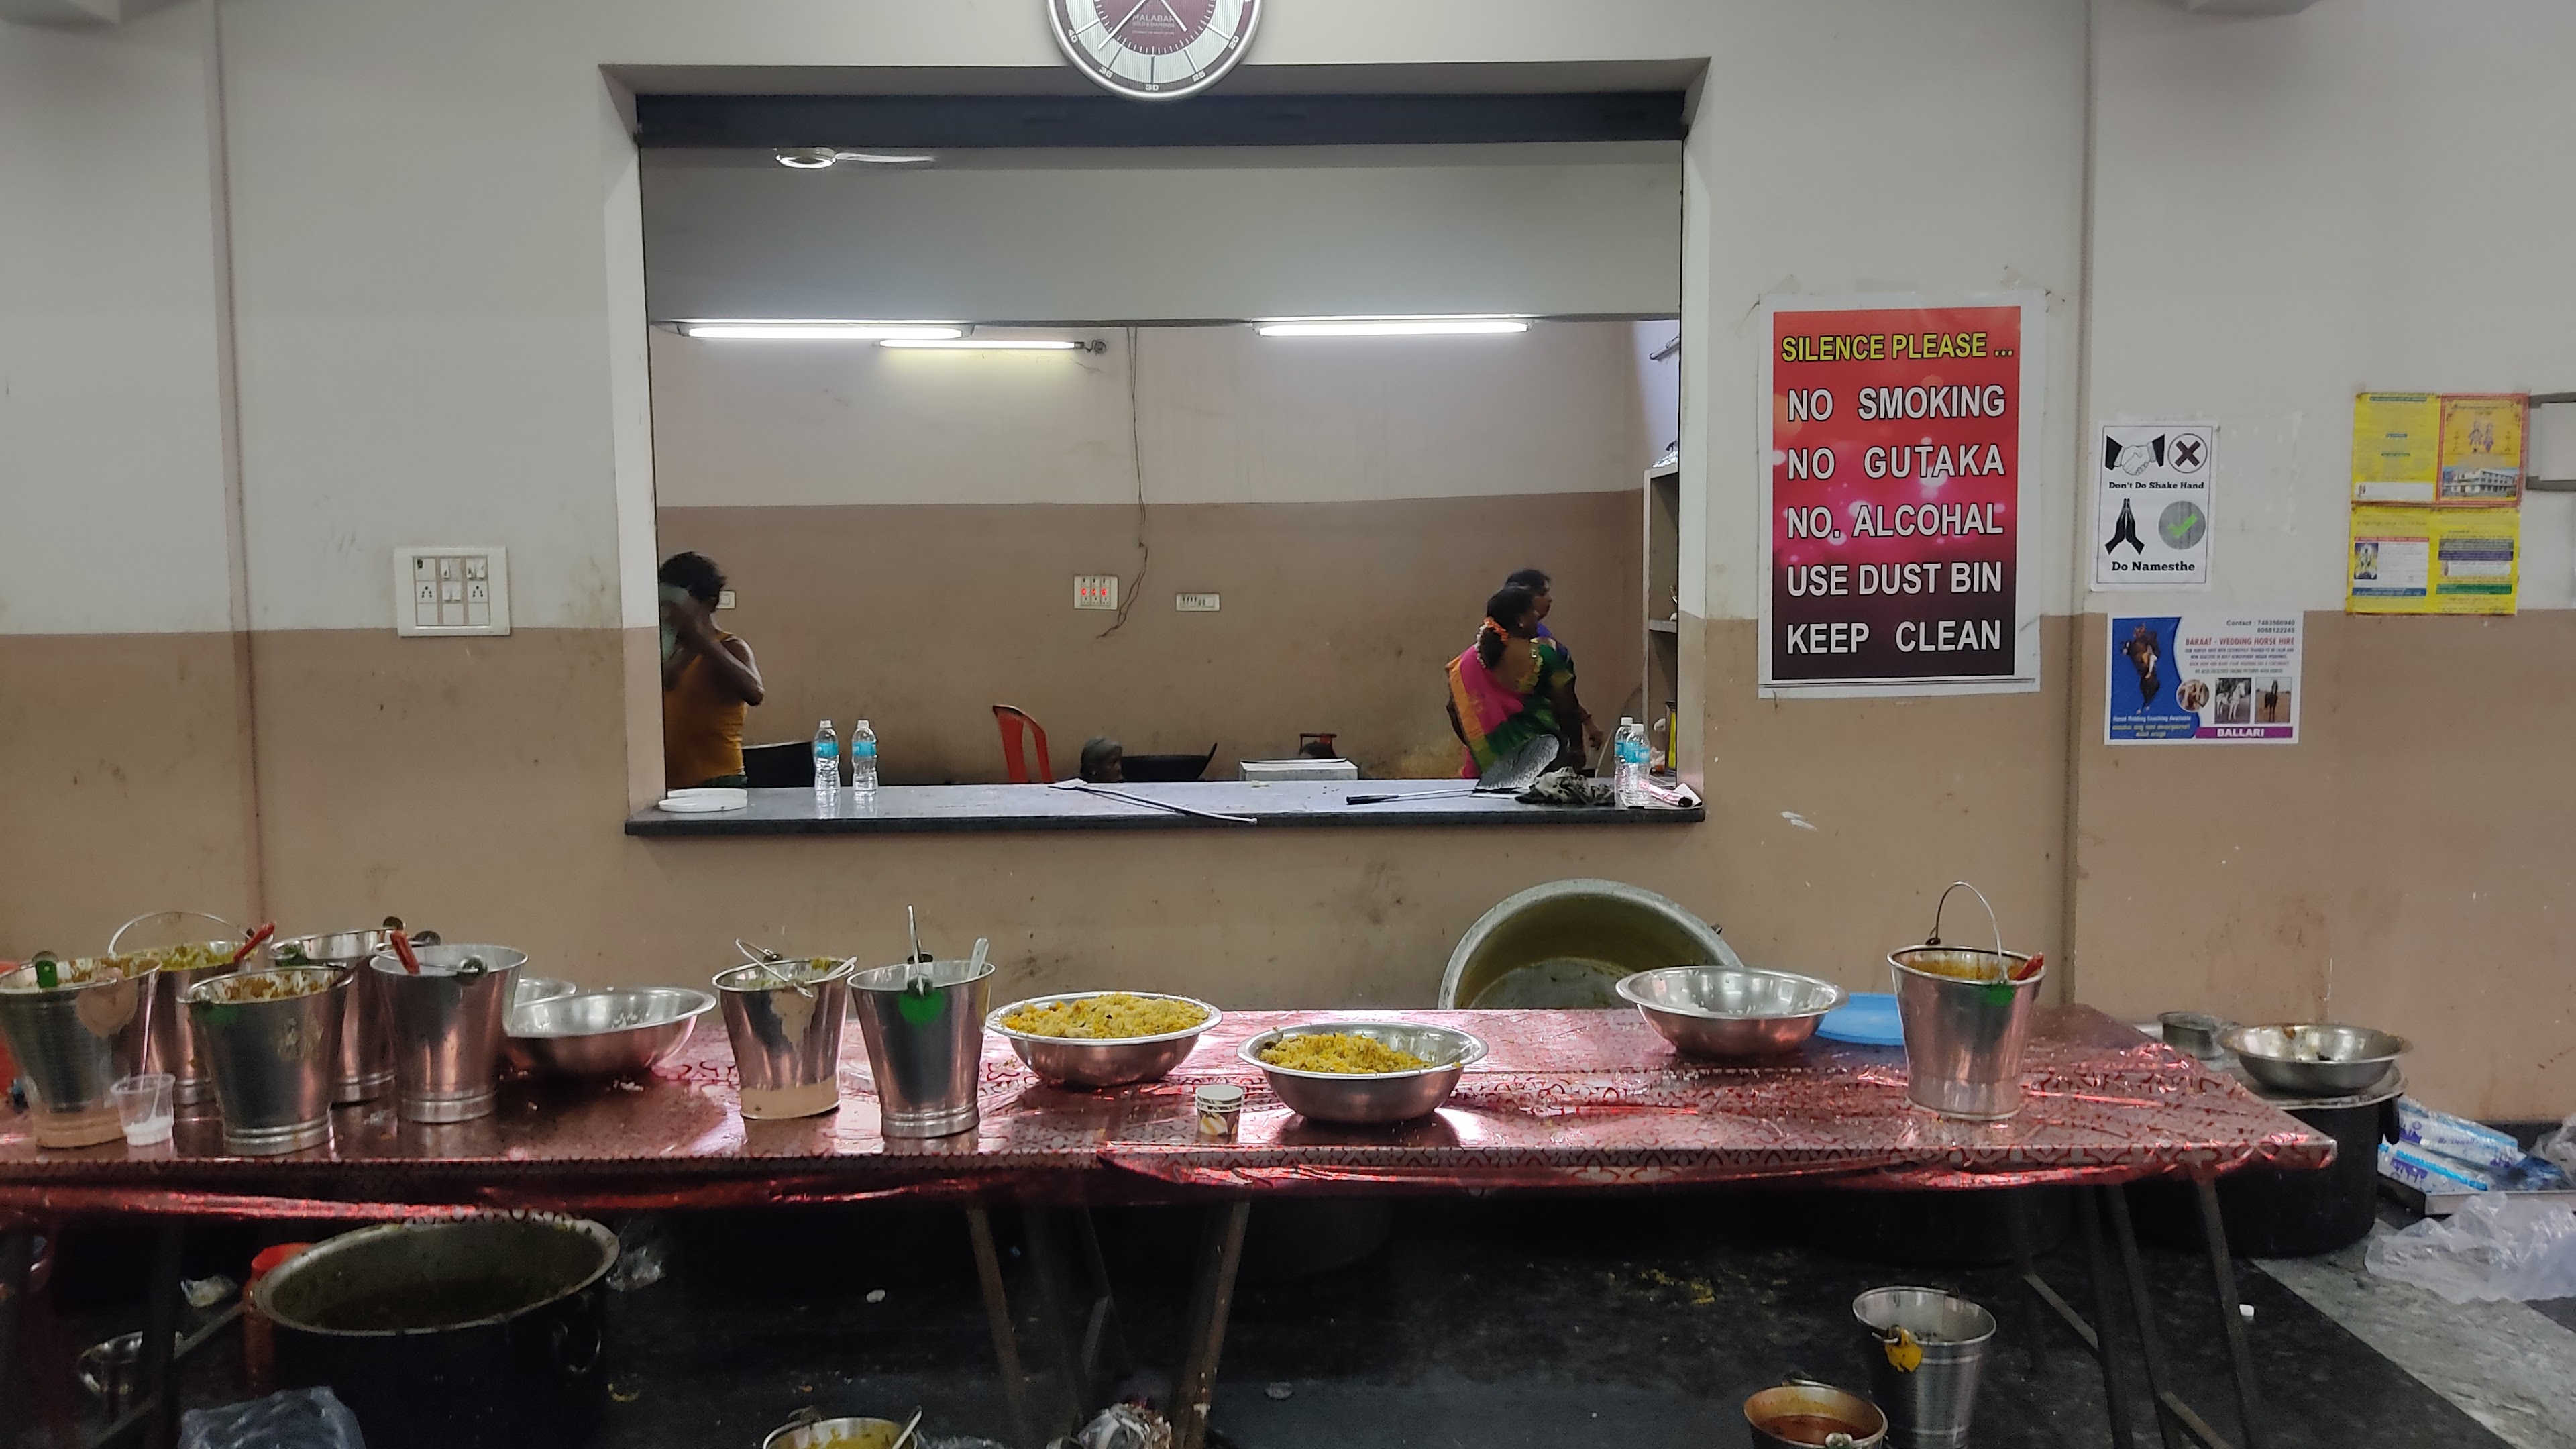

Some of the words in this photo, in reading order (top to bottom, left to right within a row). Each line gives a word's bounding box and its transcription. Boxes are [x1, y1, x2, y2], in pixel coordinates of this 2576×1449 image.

[1228, 35, 1240, 50] 20
[1192, 70, 1205, 82] 25
[1782, 334, 1885, 362] SILENCE
[1892, 332, 1987, 359] PLEASE
[1788, 388, 1834, 421] NO
[1857, 384, 2006, 420] SMOKING
[1788, 447, 1835, 480] NO
[1864, 443, 2006, 478] GUTAKA
[1787, 506, 1841, 538] NO.
[1851, 503, 2004, 537] ALCOHAL
[1787, 564, 1849, 596] USE
[1858, 562, 1942, 595] DUST
[1950, 561, 2002, 594] BIN
[2111, 561, 2128, 571] Do
[2131, 561, 2195, 571] Namesthe
[1786, 623, 1870, 655] KEEP
[1895, 619, 2001, 653] CLEAN
[2185, 637, 2212, 646] BARAAT
[2219, 637, 2252, 645] WEDDING
[2254, 637, 2276, 645] HORSE
[2278, 637, 2294, 645] HIRE
[2217, 728, 2265, 737] BALLARI
